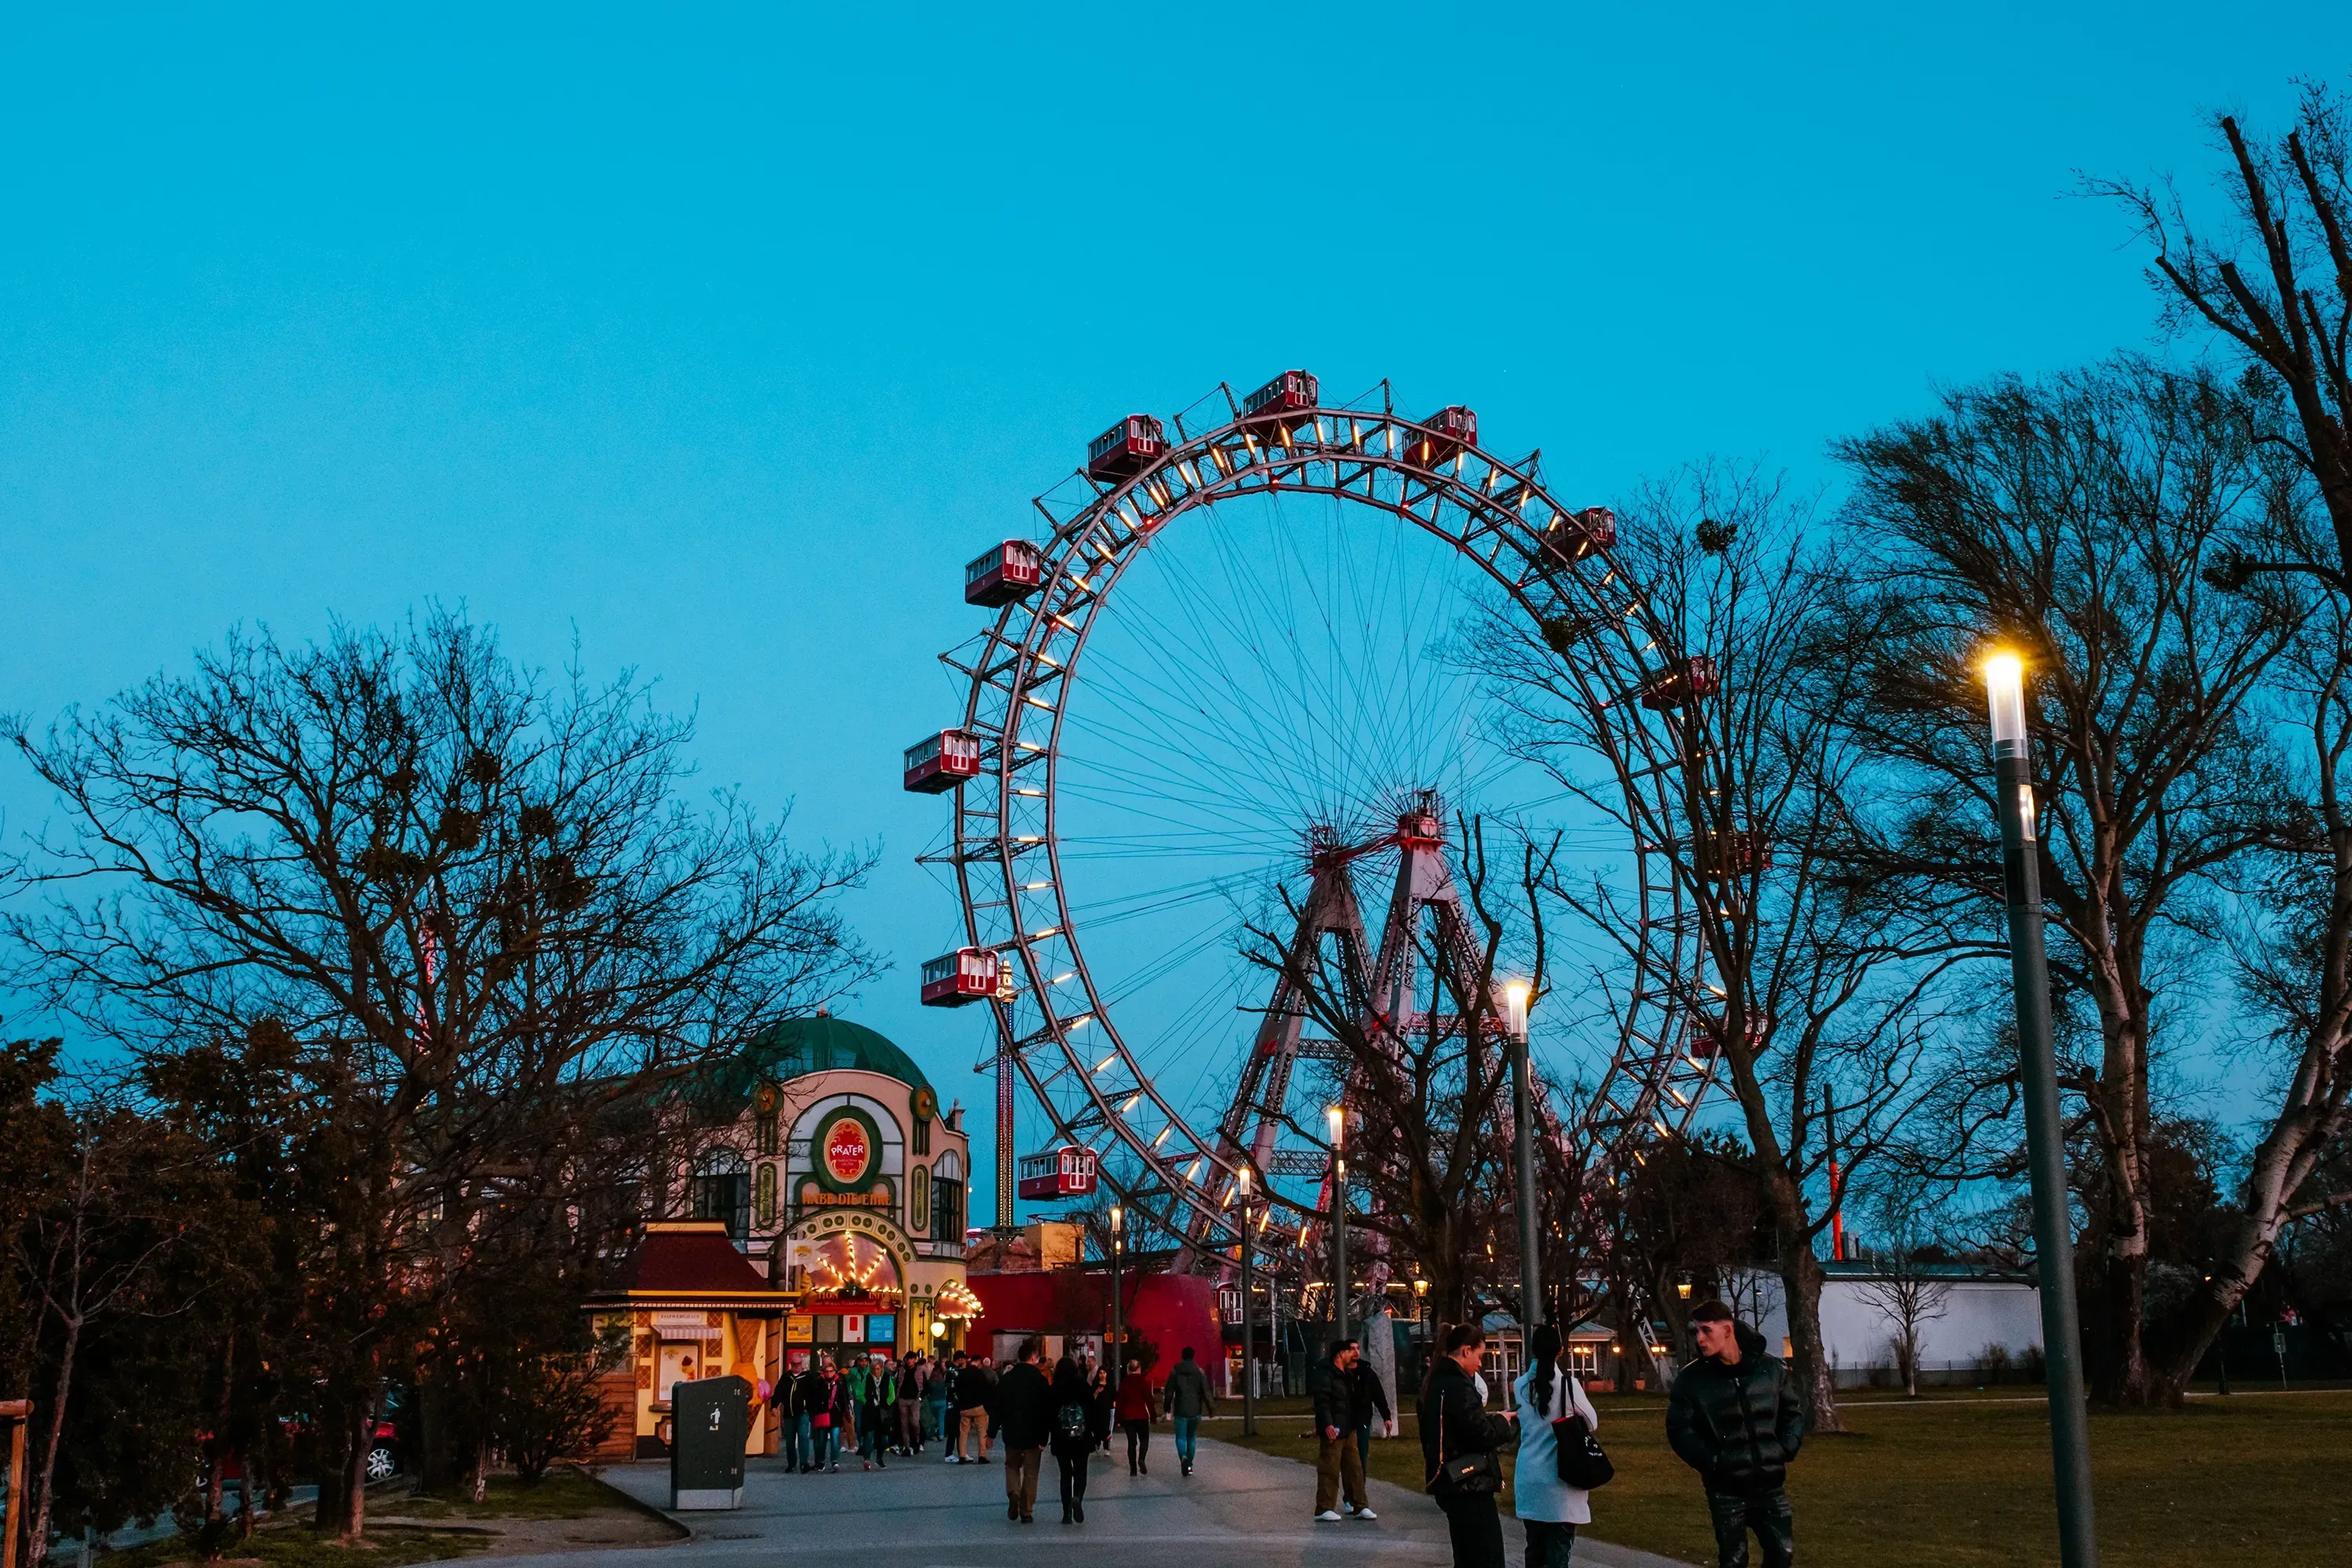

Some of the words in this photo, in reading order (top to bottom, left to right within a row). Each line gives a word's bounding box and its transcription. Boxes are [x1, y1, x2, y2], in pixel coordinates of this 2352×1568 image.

[831, 1145, 863, 1156] PRATER
[802, 1192, 833, 1204] HABE
[838, 1192, 859, 1205] DIE
[862, 1193, 891, 1206] EHRE
